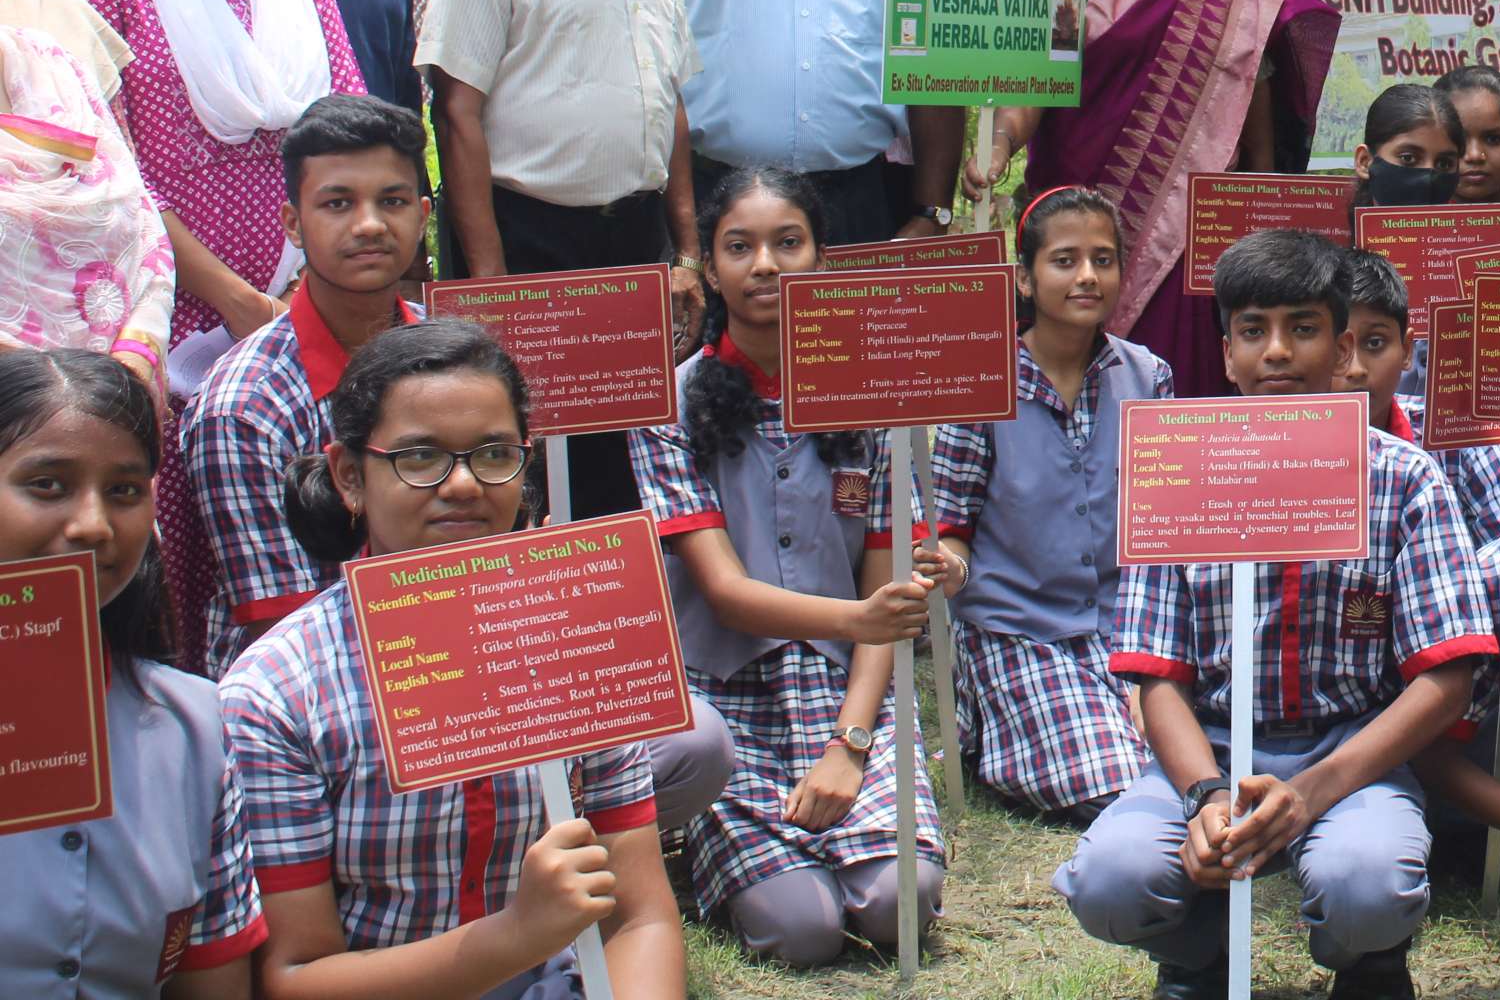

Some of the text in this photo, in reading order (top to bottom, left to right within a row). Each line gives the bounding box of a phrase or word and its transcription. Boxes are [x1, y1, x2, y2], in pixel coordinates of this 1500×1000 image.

[931, 23, 1047, 51] HERBAL GARDEN
[1377, 37, 1469, 76] Botanic
[906, 74, 922, 92] Situ
[925, 74, 978, 92] Conservation
[981, 76, 990, 92] of
[992, 77, 1028, 94] Medicinal
[1030, 78, 1048, 94] Plant
[1049, 79, 1074, 98] Species
[1382, 218, 1428, 228] Medicinal
[1431, 218, 1456, 227] Plant
[1466, 217, 1494, 227] Serial
[458, 280, 638, 305] Medicinal Plant Serial No. 10
[812, 280, 983, 299] Medicinal Plant Serial No. 32
[1158, 409, 1332, 424] Medicinal Plant Serial No. 9
[389, 532, 621, 587] Medicinal Plant Serial No. 16
[22, 586, 34, 604] 8
[367, 558, 625, 612] Scientific Name Tinospora cordifolia (Willd.)
[24, 618, 62, 640] Stapf
[376, 609, 568, 652] Family Menispermaceae
[384, 673, 429, 692] English
[430, 668, 464, 682] Name
[523, 648, 559, 666] leaved
[561, 637, 615, 658] moonseed
[10, 751, 88, 775] flavouring
